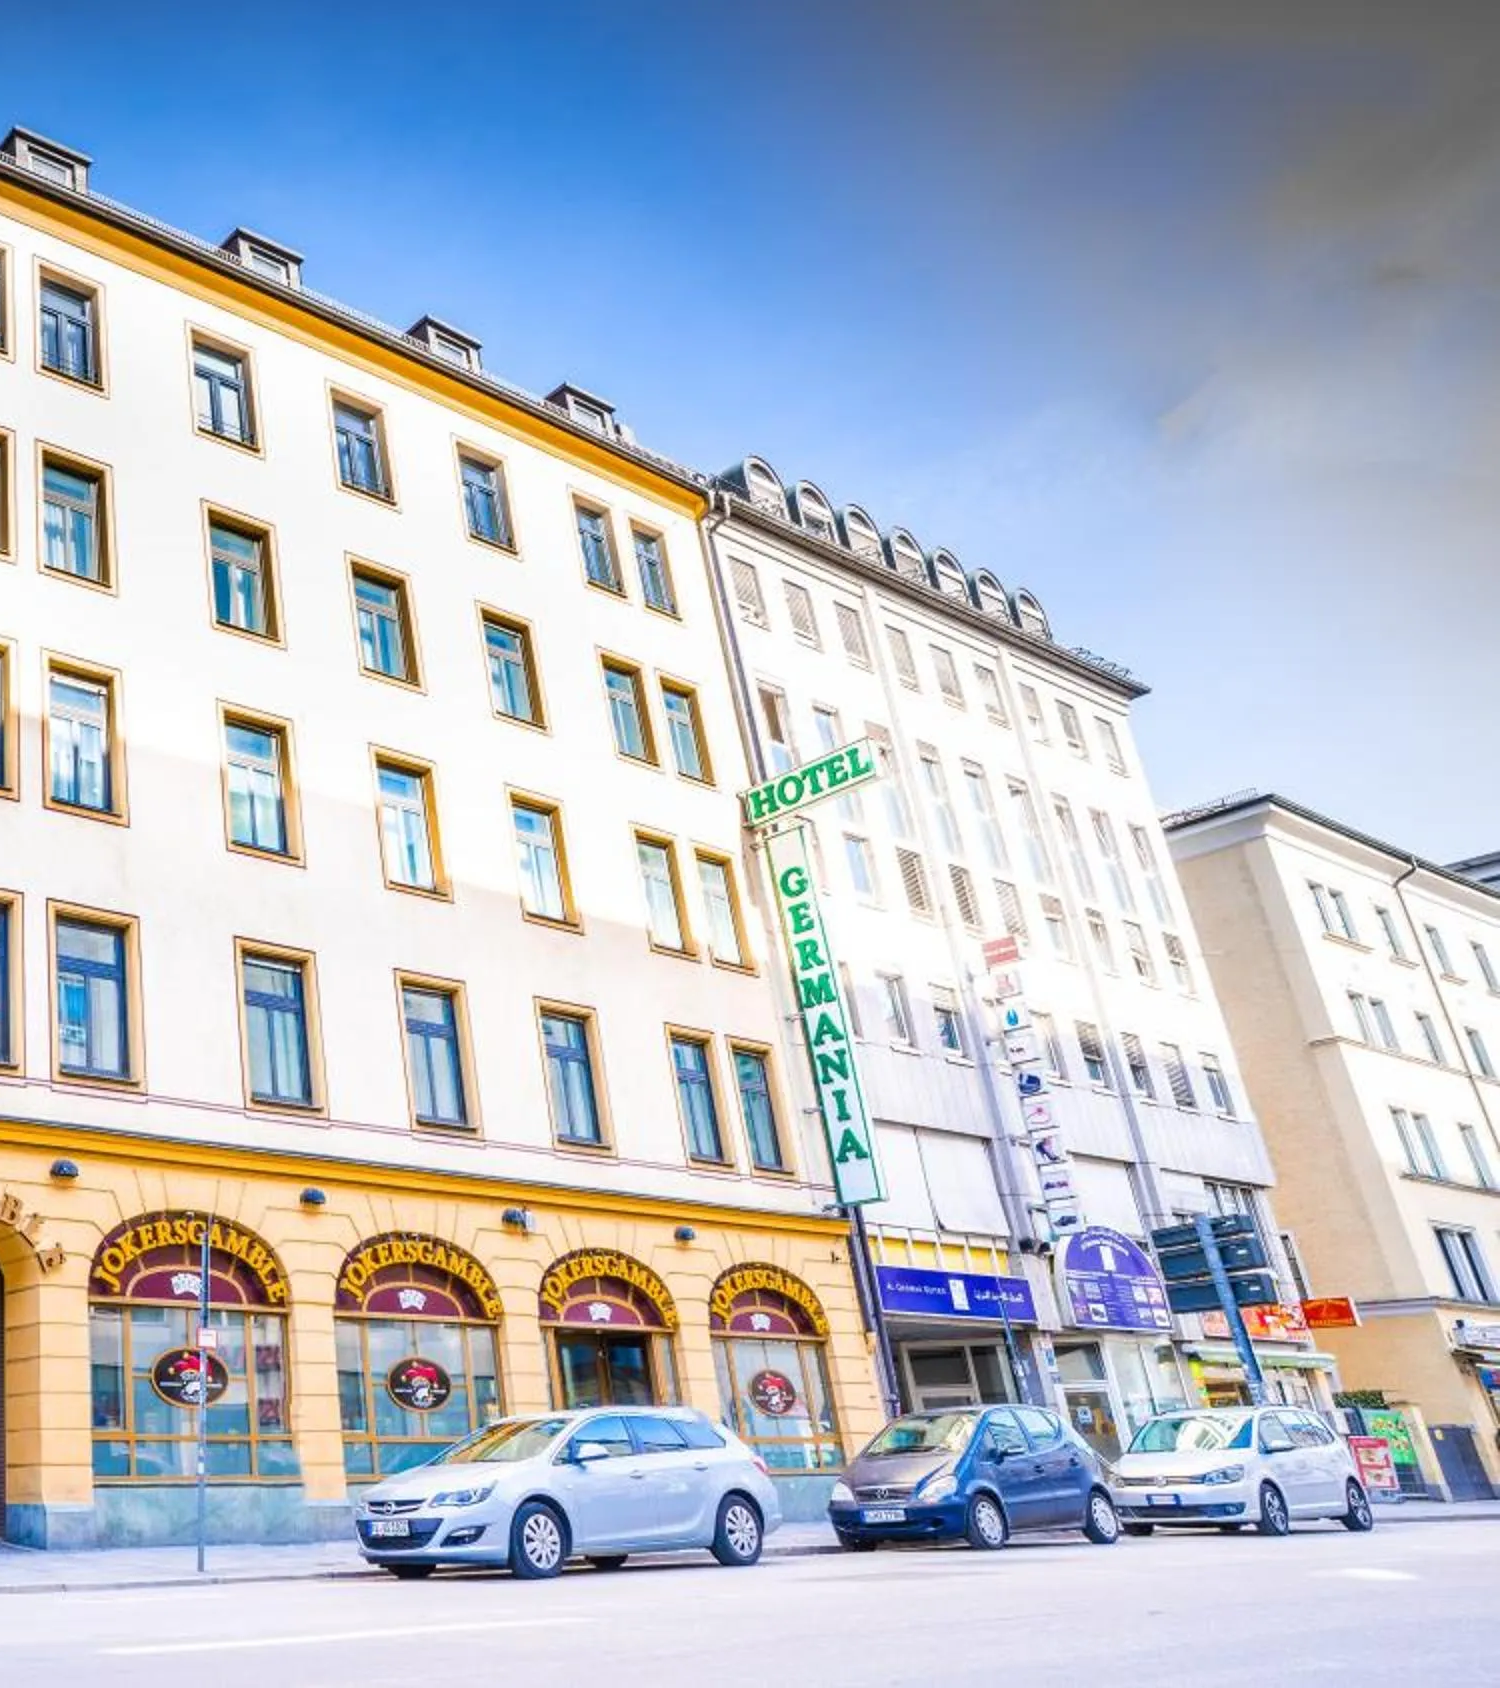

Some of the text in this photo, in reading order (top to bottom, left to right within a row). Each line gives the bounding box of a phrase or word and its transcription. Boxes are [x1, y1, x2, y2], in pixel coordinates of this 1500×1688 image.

[750, 747, 872, 818] HOTEL
[780, 866, 869, 1163] GERMANIA
[94, 1219, 289, 1303] JOKERSGAMBLE
[341, 1240, 505, 1320] JOKERSGAMBLE
[542, 1256, 678, 1327] JOKERSGAMBLE
